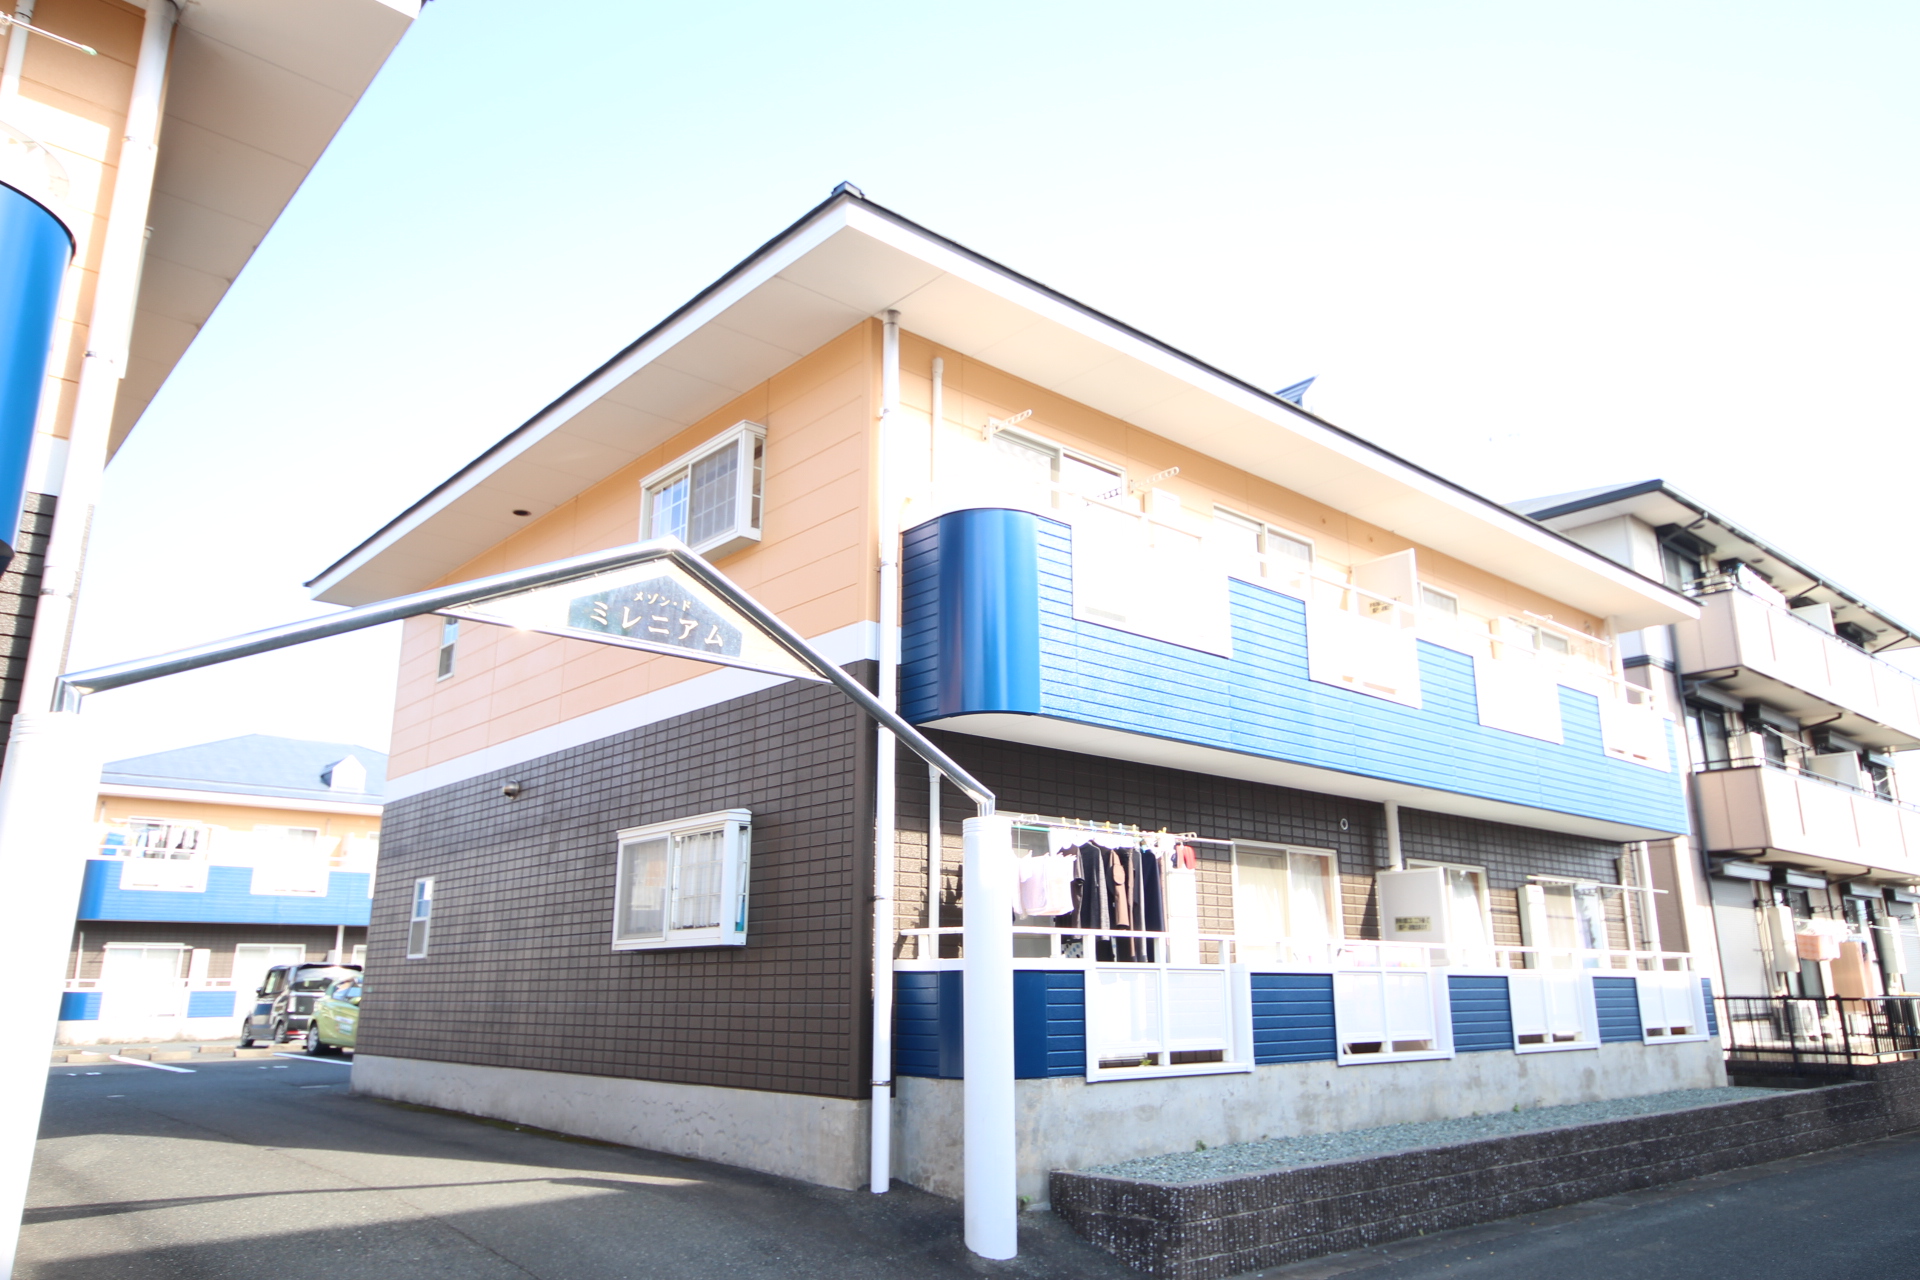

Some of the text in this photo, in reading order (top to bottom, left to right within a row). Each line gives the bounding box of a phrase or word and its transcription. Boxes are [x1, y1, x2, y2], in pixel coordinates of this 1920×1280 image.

[590, 601, 723, 647] ミレニアム
